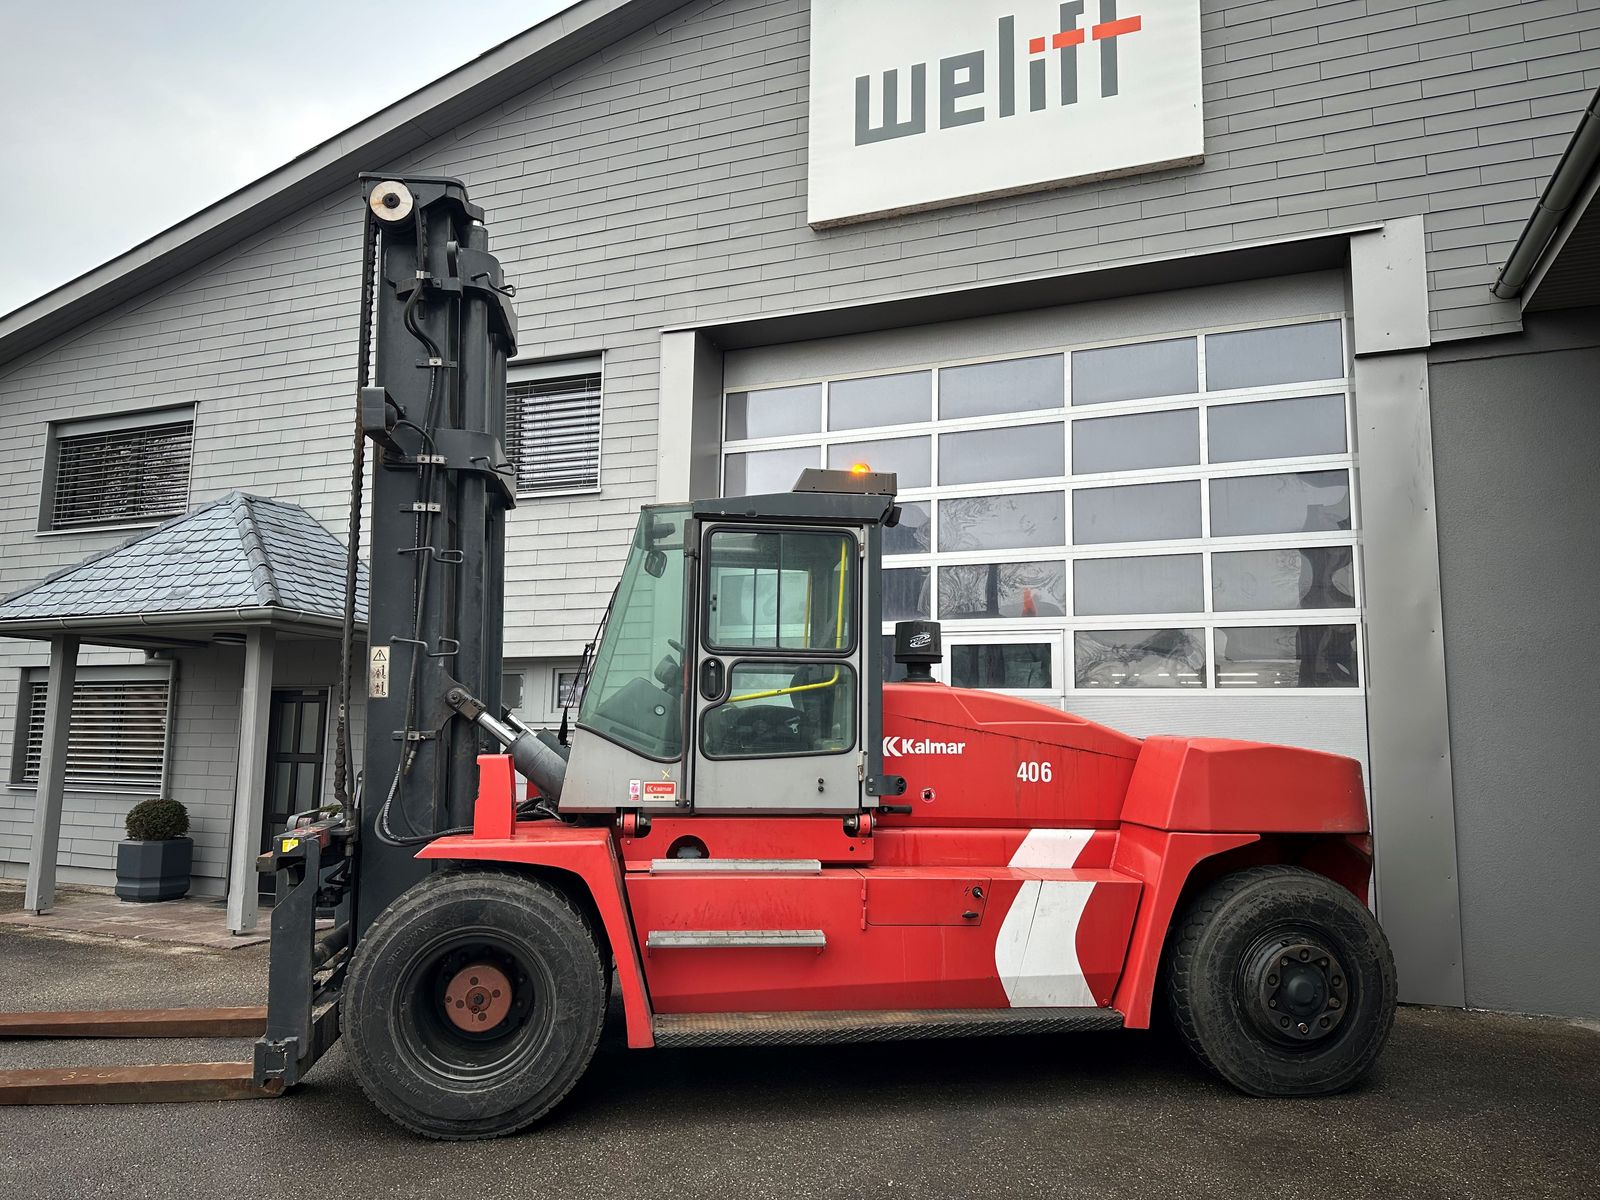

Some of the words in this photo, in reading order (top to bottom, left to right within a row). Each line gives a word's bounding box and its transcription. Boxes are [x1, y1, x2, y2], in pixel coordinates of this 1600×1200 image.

[855, 0, 1141, 146] welift
[902, 738, 966, 755] Kalmar
[1016, 762, 1052, 783] 406
